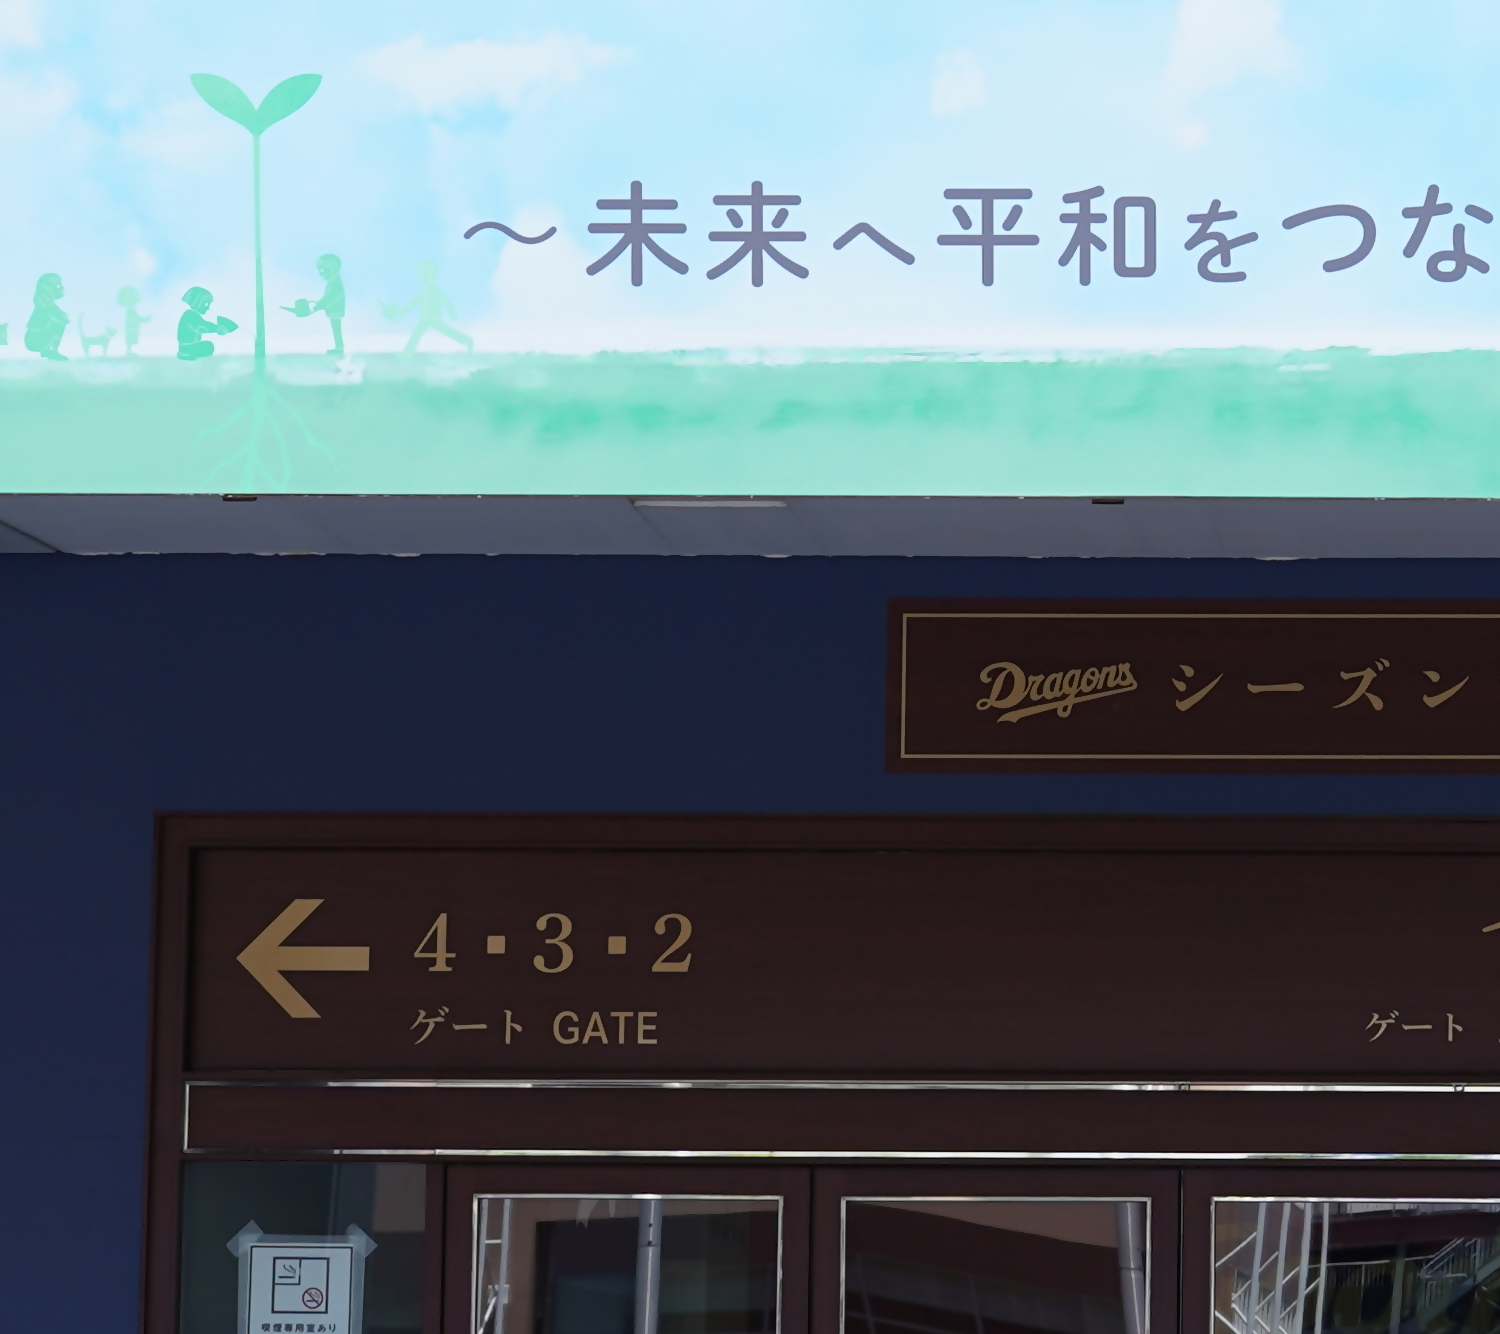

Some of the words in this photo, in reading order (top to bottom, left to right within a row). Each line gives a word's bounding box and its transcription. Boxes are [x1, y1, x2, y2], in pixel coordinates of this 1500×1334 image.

[976, 661, 1138, 723] Dragons
[409, 1005, 523, 1045] ゲート
[552, 1011, 658, 1045] GATE
[1364, 1010, 1463, 1042] ゲート
